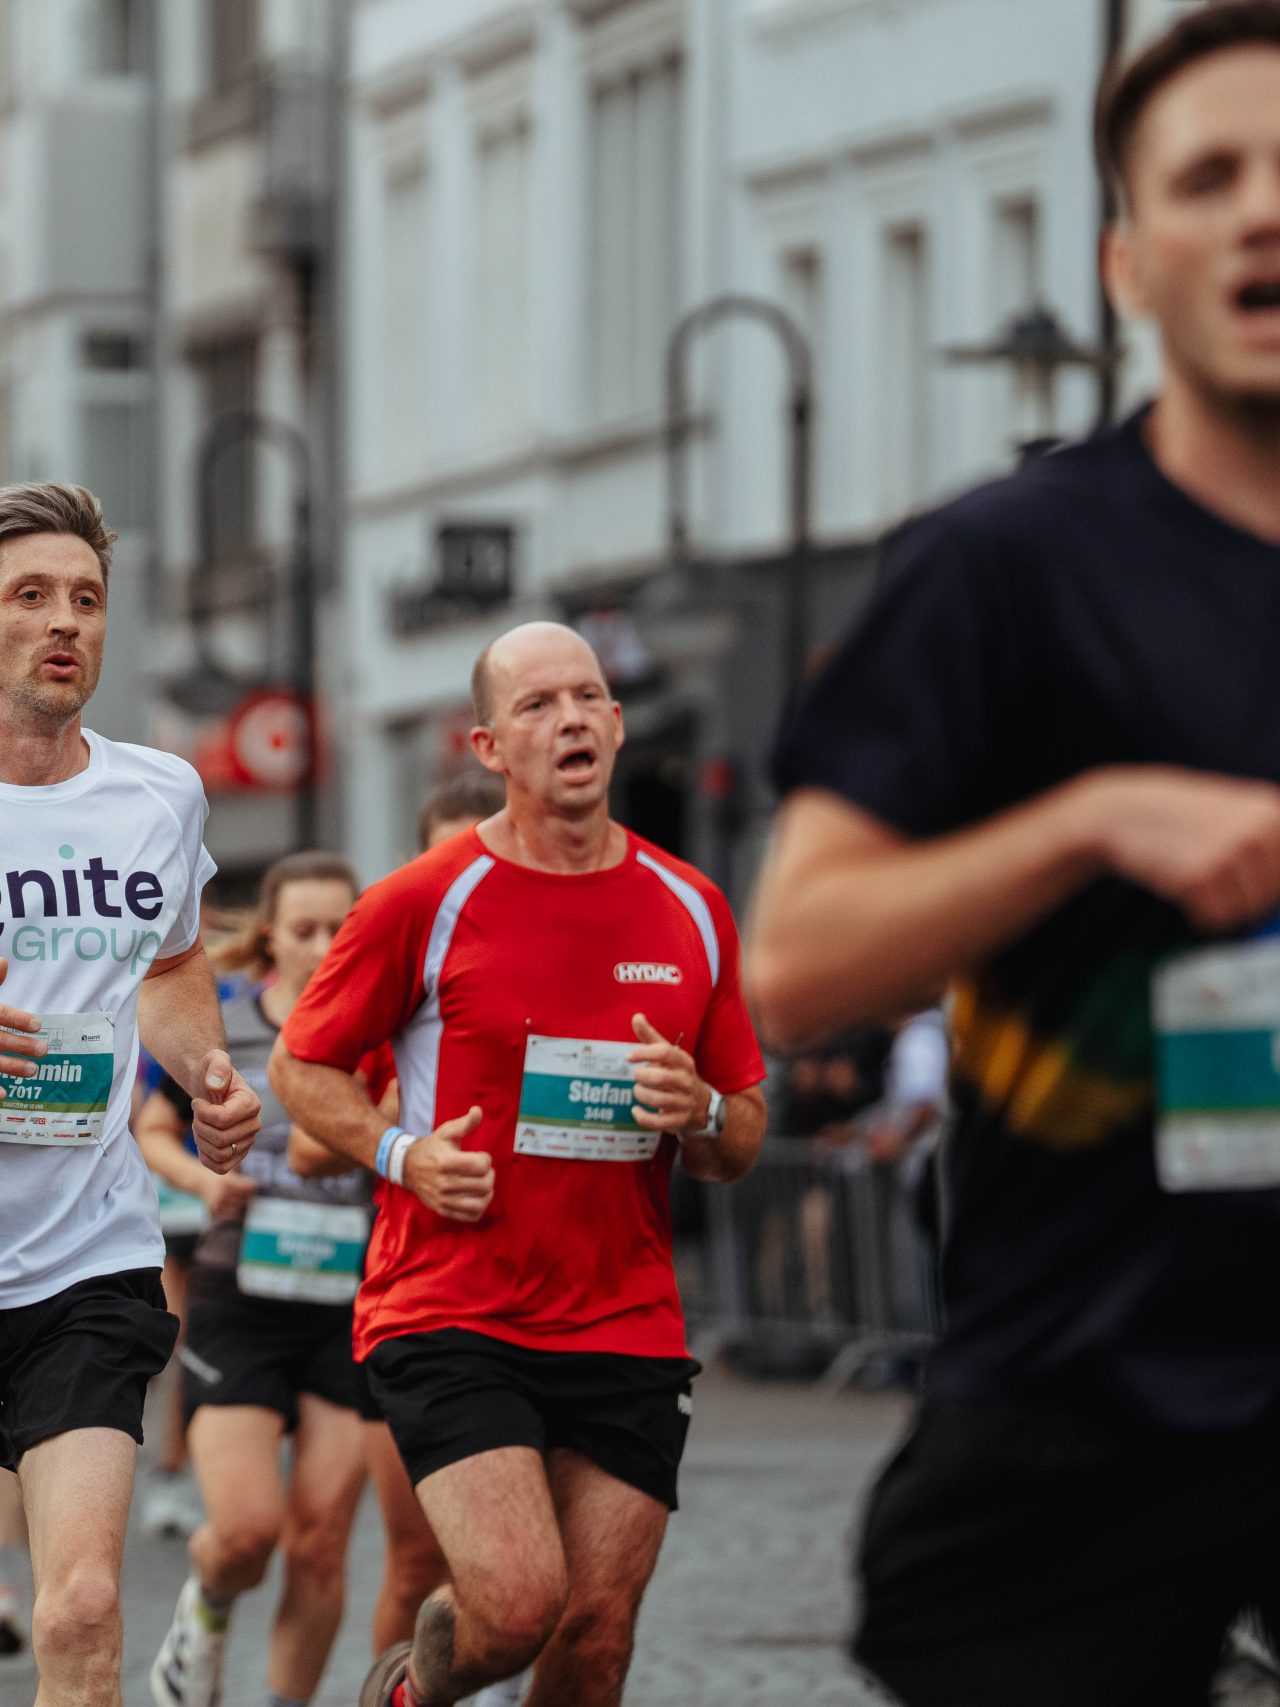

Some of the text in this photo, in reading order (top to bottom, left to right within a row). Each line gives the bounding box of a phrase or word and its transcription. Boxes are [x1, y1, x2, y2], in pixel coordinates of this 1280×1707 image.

[618, 964, 679, 983] HYDAC
[8, 1085, 43, 1100] 7017
[568, 1080, 633, 1105] Stefan
